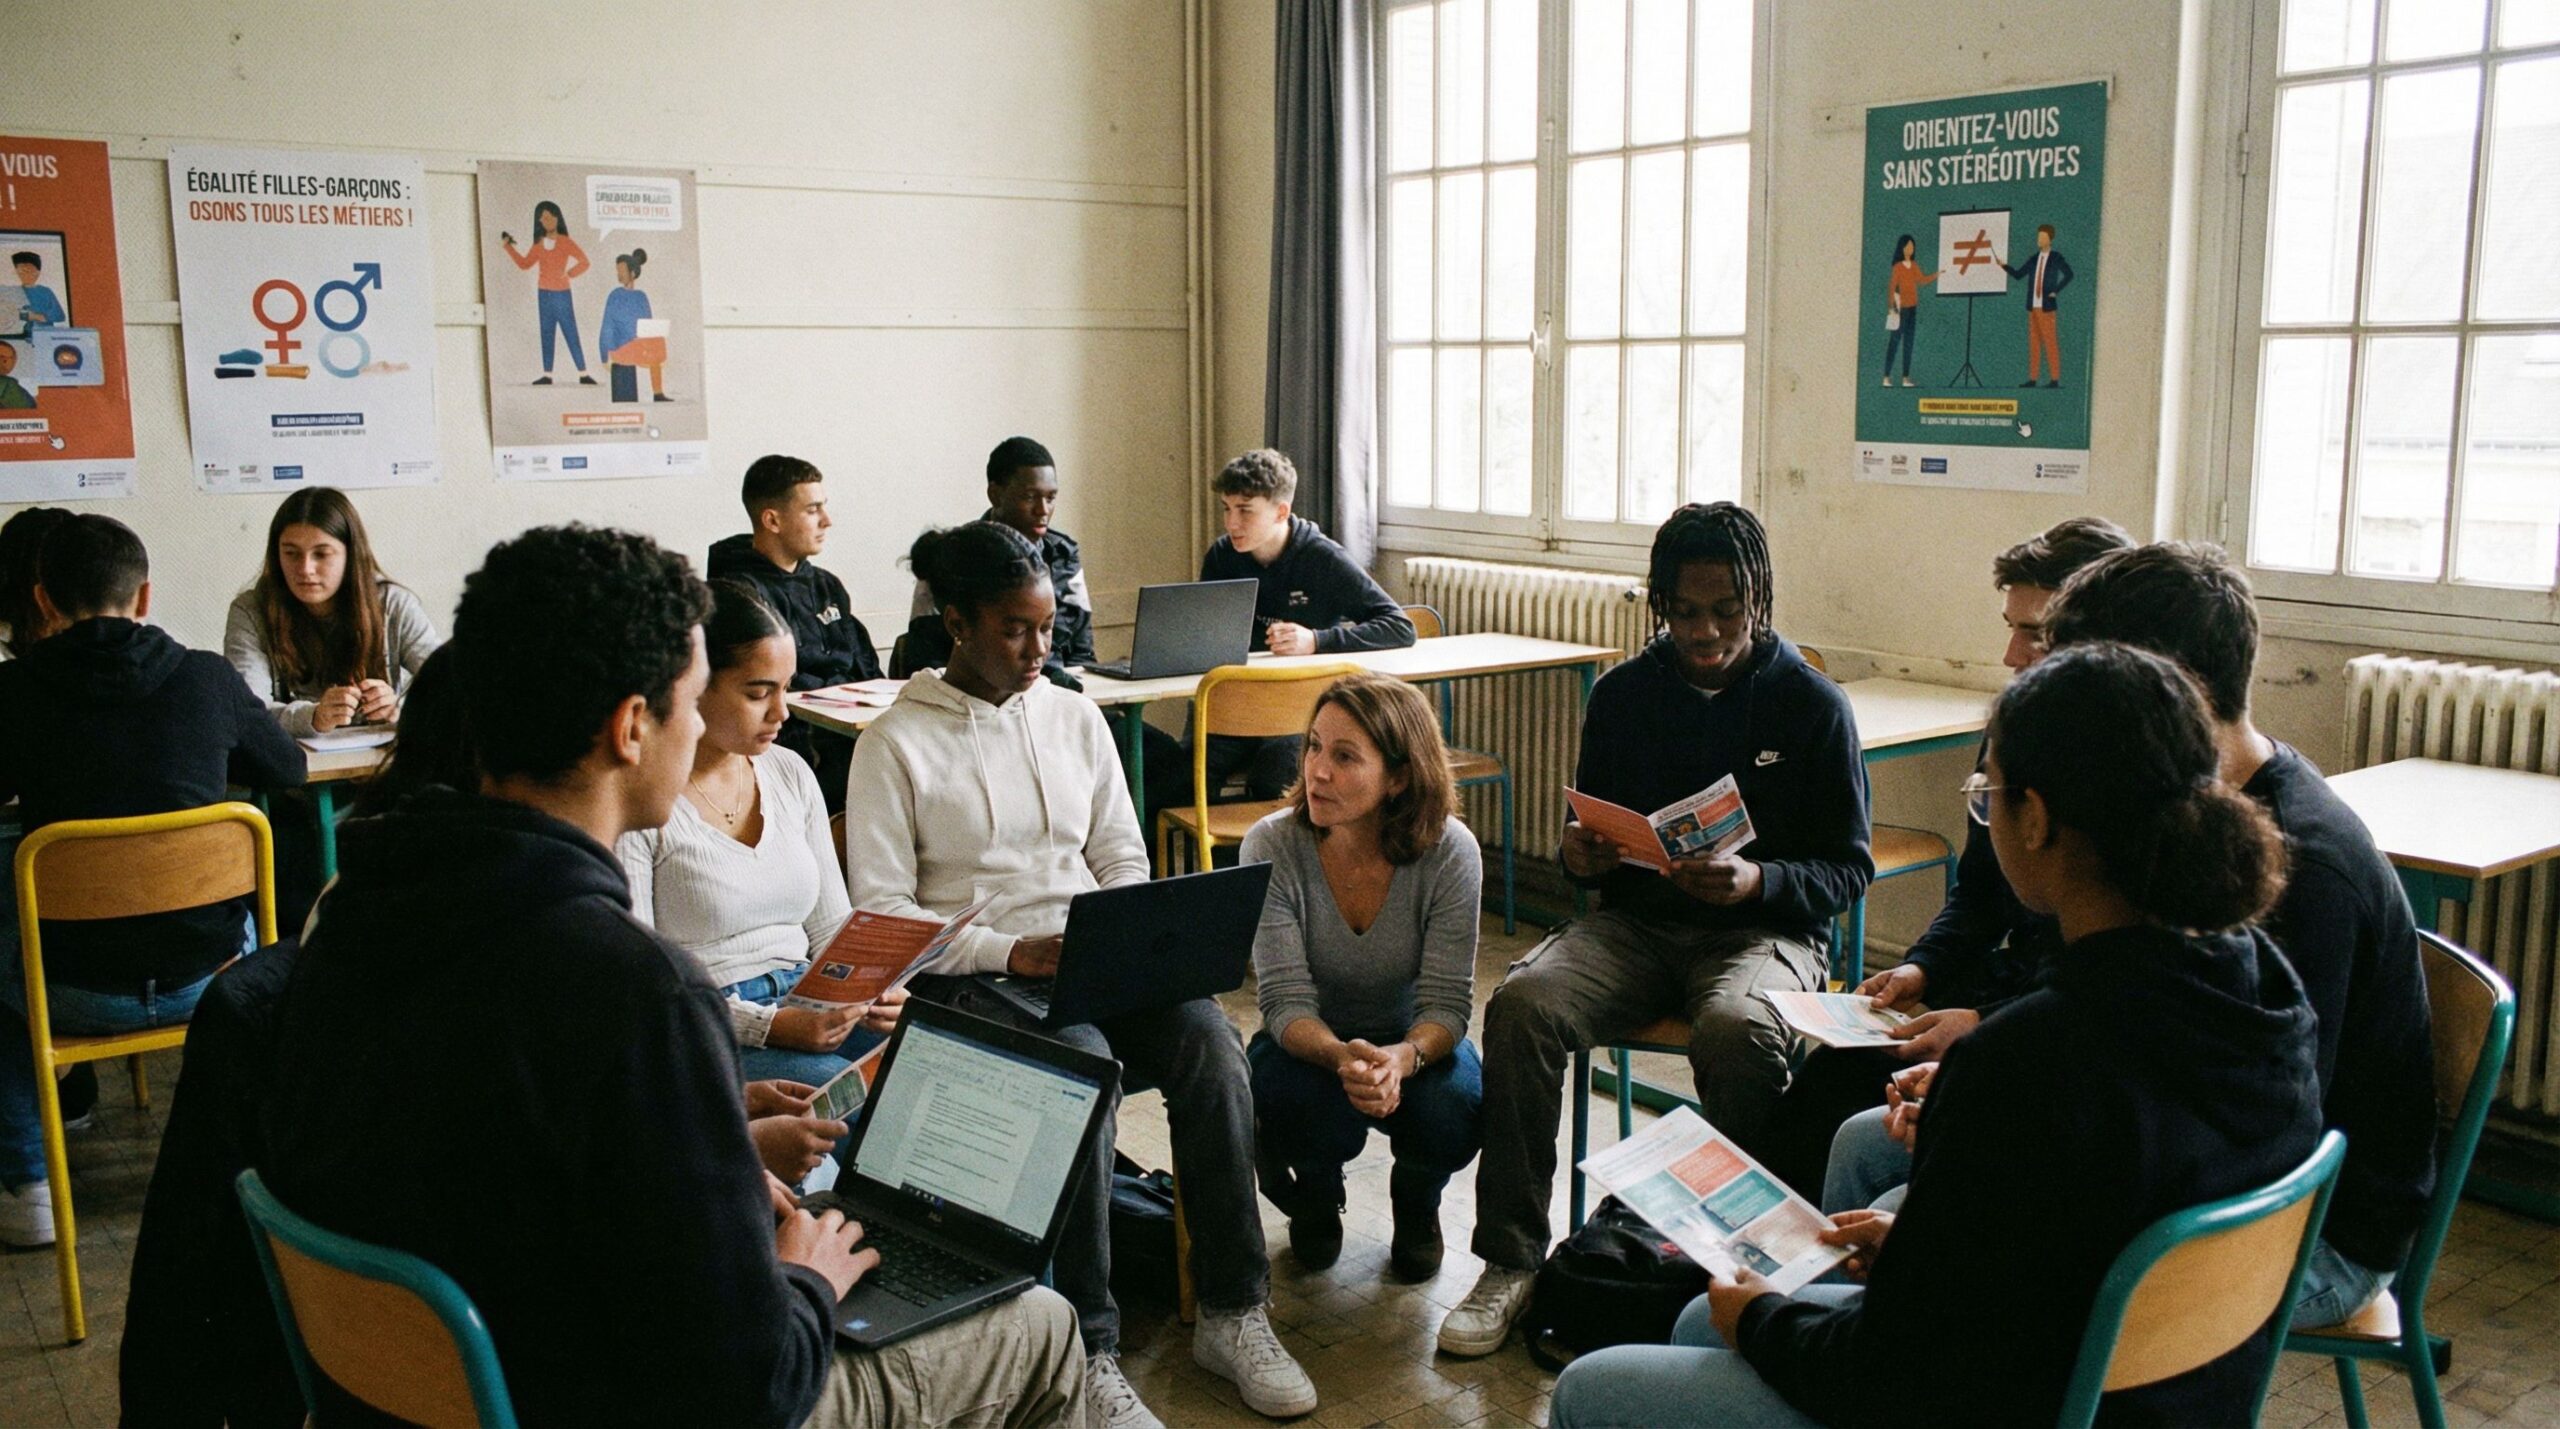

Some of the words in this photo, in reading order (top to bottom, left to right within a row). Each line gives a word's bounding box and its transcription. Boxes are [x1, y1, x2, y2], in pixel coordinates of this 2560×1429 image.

[1903, 106, 2060, 151] ORIENTEZ-VOUS
[0, 153, 58, 178] VOUS
[1882, 158, 1933, 190] SANS
[1937, 145, 2081, 186] STÉRÉOTYPES
[187, 166, 258, 194] ÉGALITÉ
[263, 174, 401, 202] FILLES-GARÇONS
[190, 200, 247, 222] OSONS
[250, 203, 294, 223] TOUS
[299, 204, 329, 225] LES
[333, 202, 404, 227] MÉTIERS
